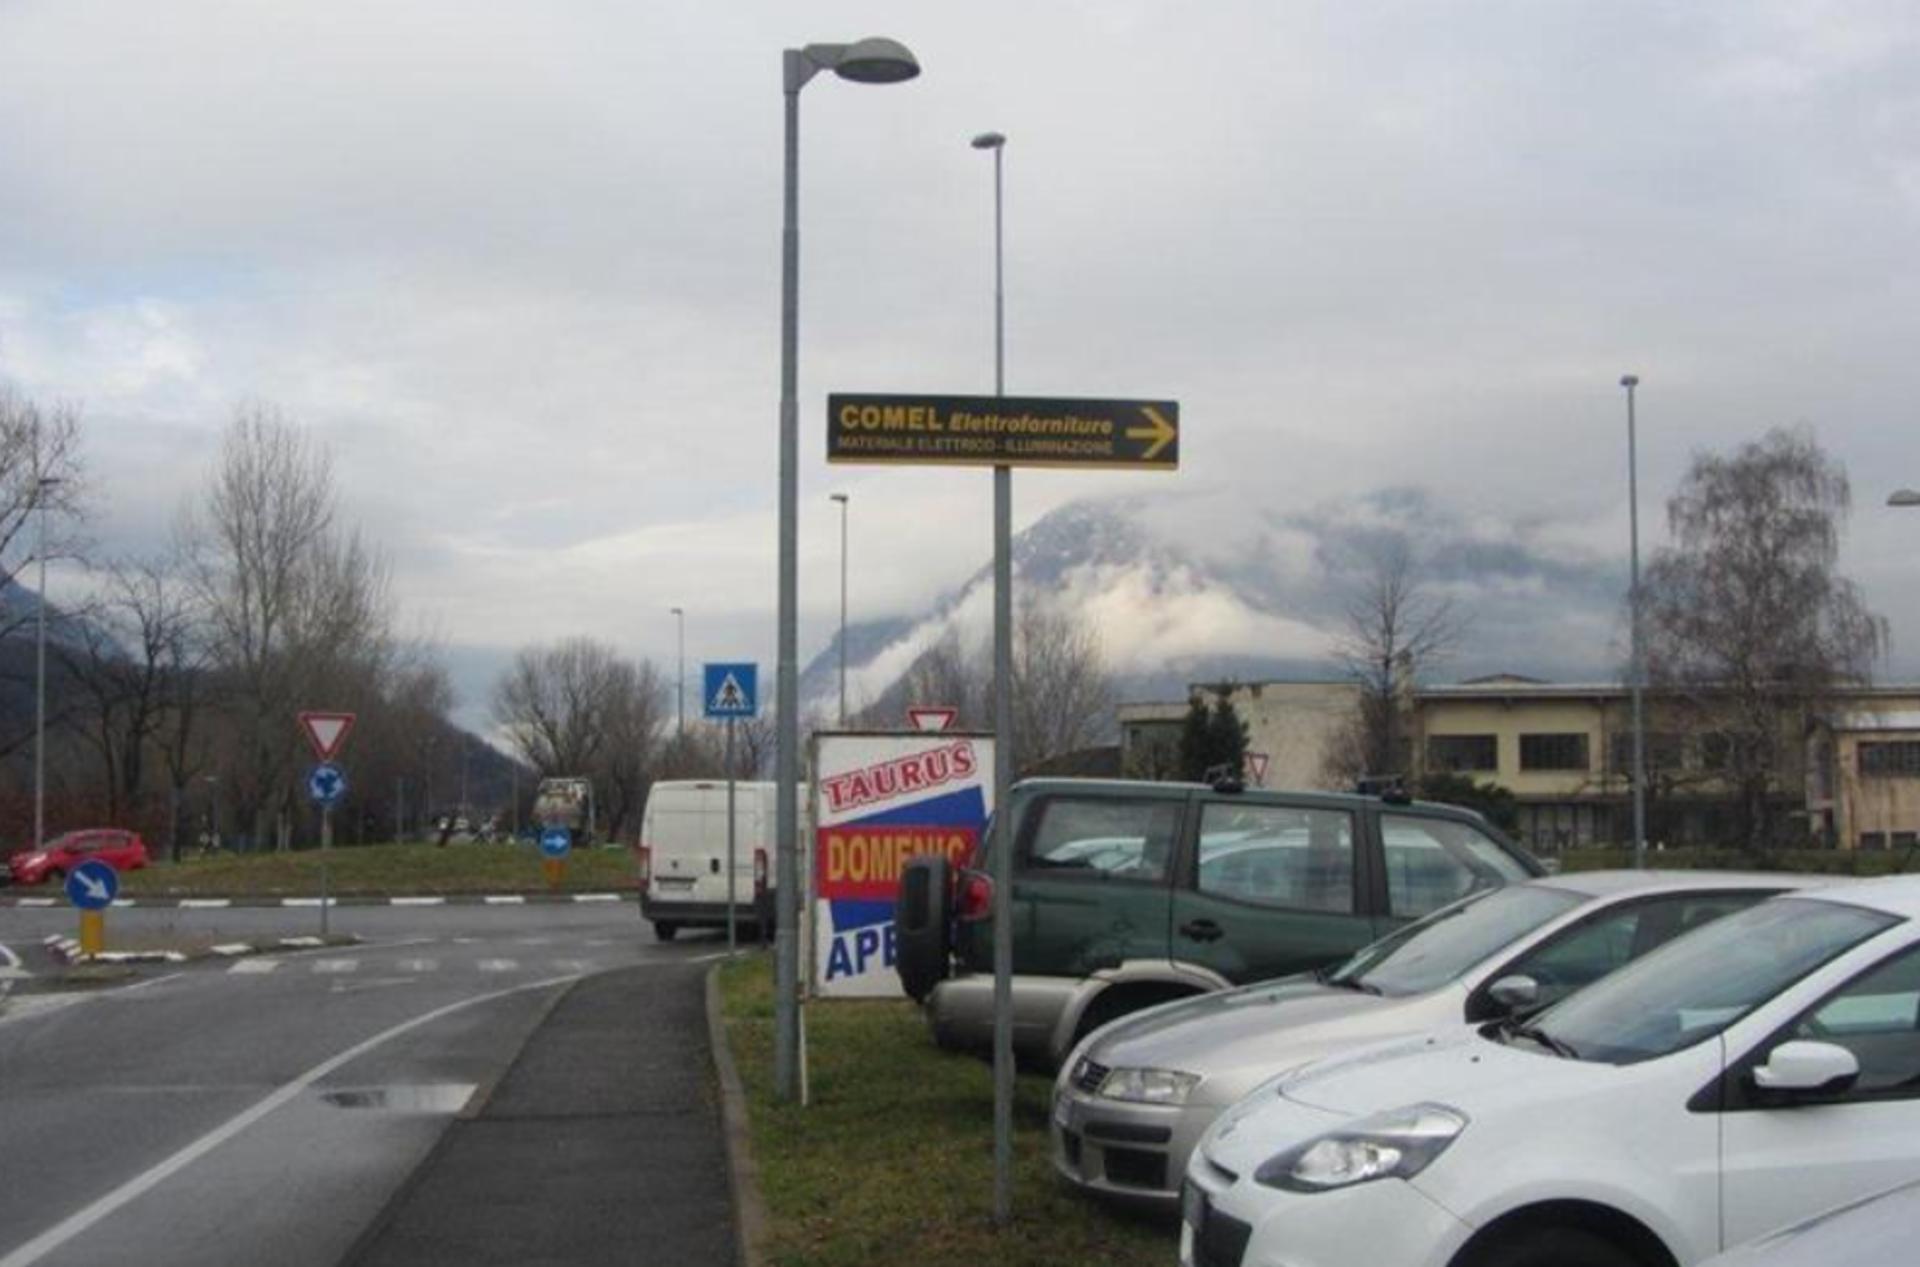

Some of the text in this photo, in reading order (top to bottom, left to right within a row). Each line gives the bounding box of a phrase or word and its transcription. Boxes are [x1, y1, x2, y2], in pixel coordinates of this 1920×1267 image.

[840, 404, 1114, 435] COMEL Elettroforniture
[918, 437, 996, 452] ELETTRICO
[824, 742, 975, 811] TAURUS
